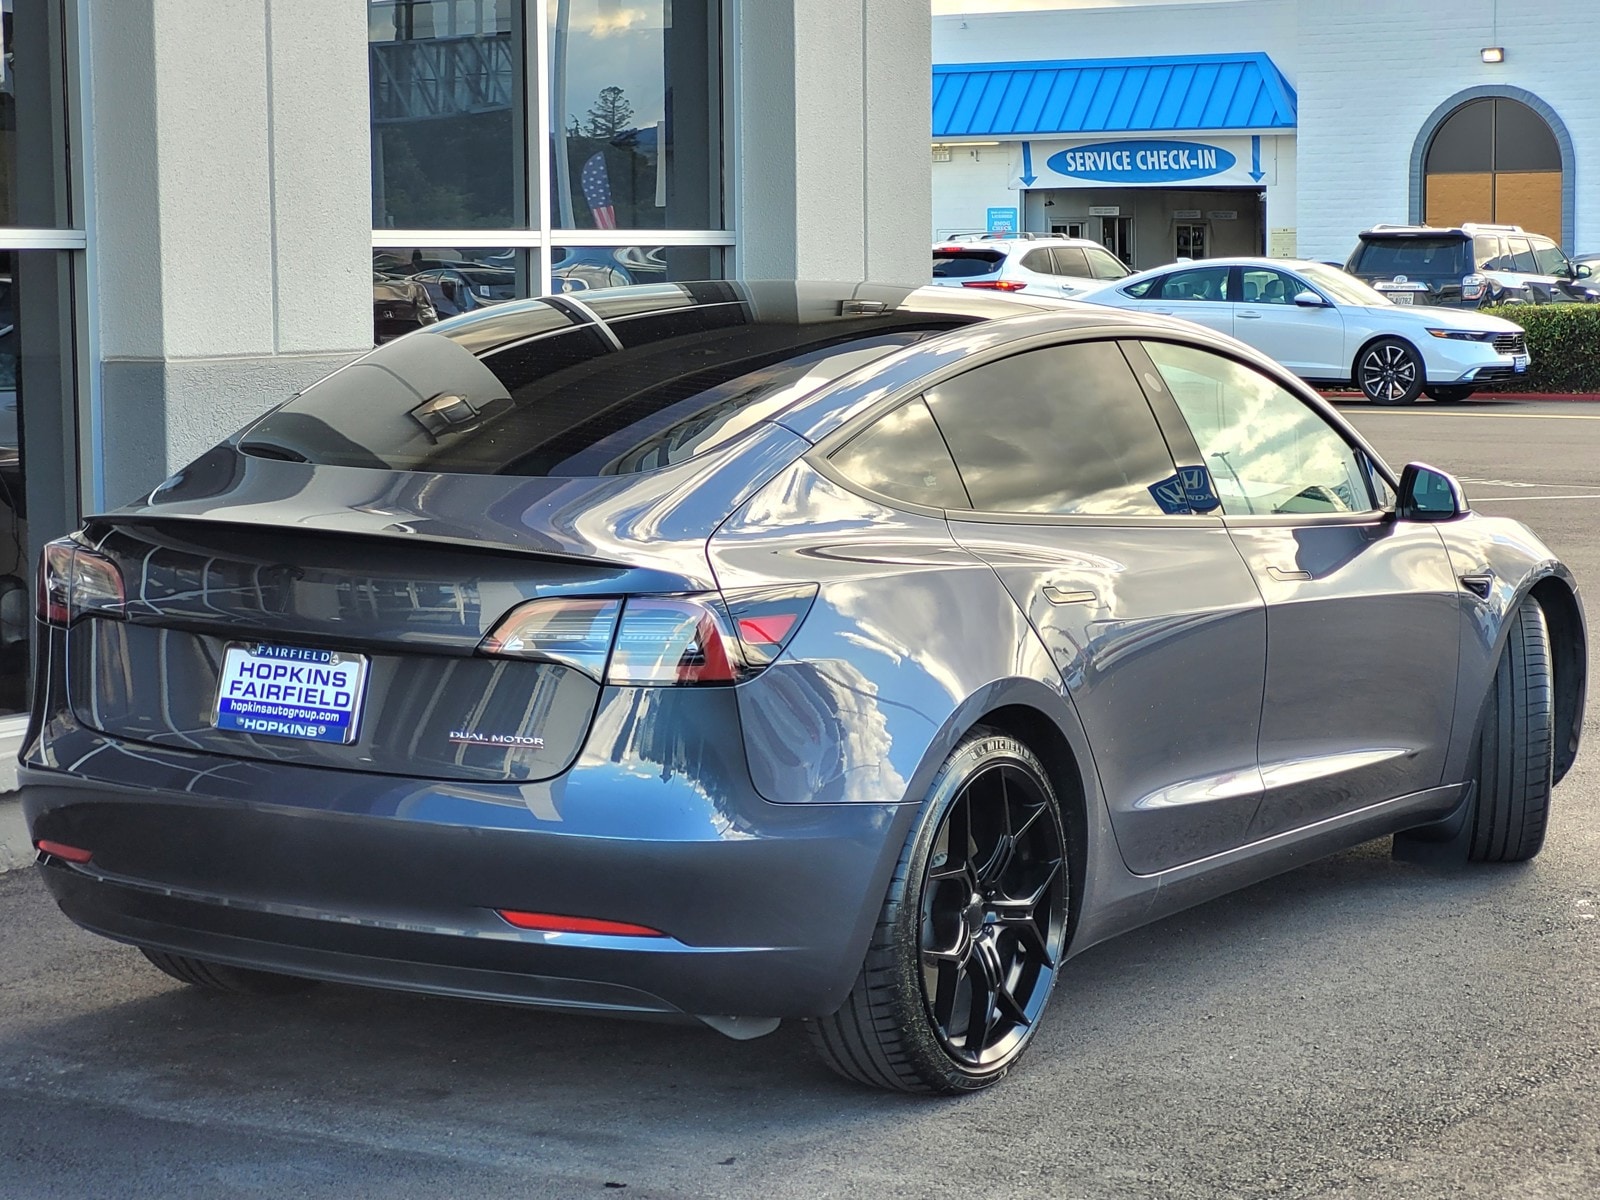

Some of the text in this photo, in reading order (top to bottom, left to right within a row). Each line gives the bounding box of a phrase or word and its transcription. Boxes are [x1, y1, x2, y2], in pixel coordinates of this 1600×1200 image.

[1066, 149, 1216, 171] SERVICE CHECK-IN
[258, 645, 330, 662] FAIRFIELD
[239, 661, 347, 688] HOPKINS
[229, 680, 350, 708] FAIRFIELD
[230, 700, 340, 722] hopkinsautogroup.com
[244, 719, 318, 737] HOPKINS
[449, 731, 544, 745] DUAL MOTOR
